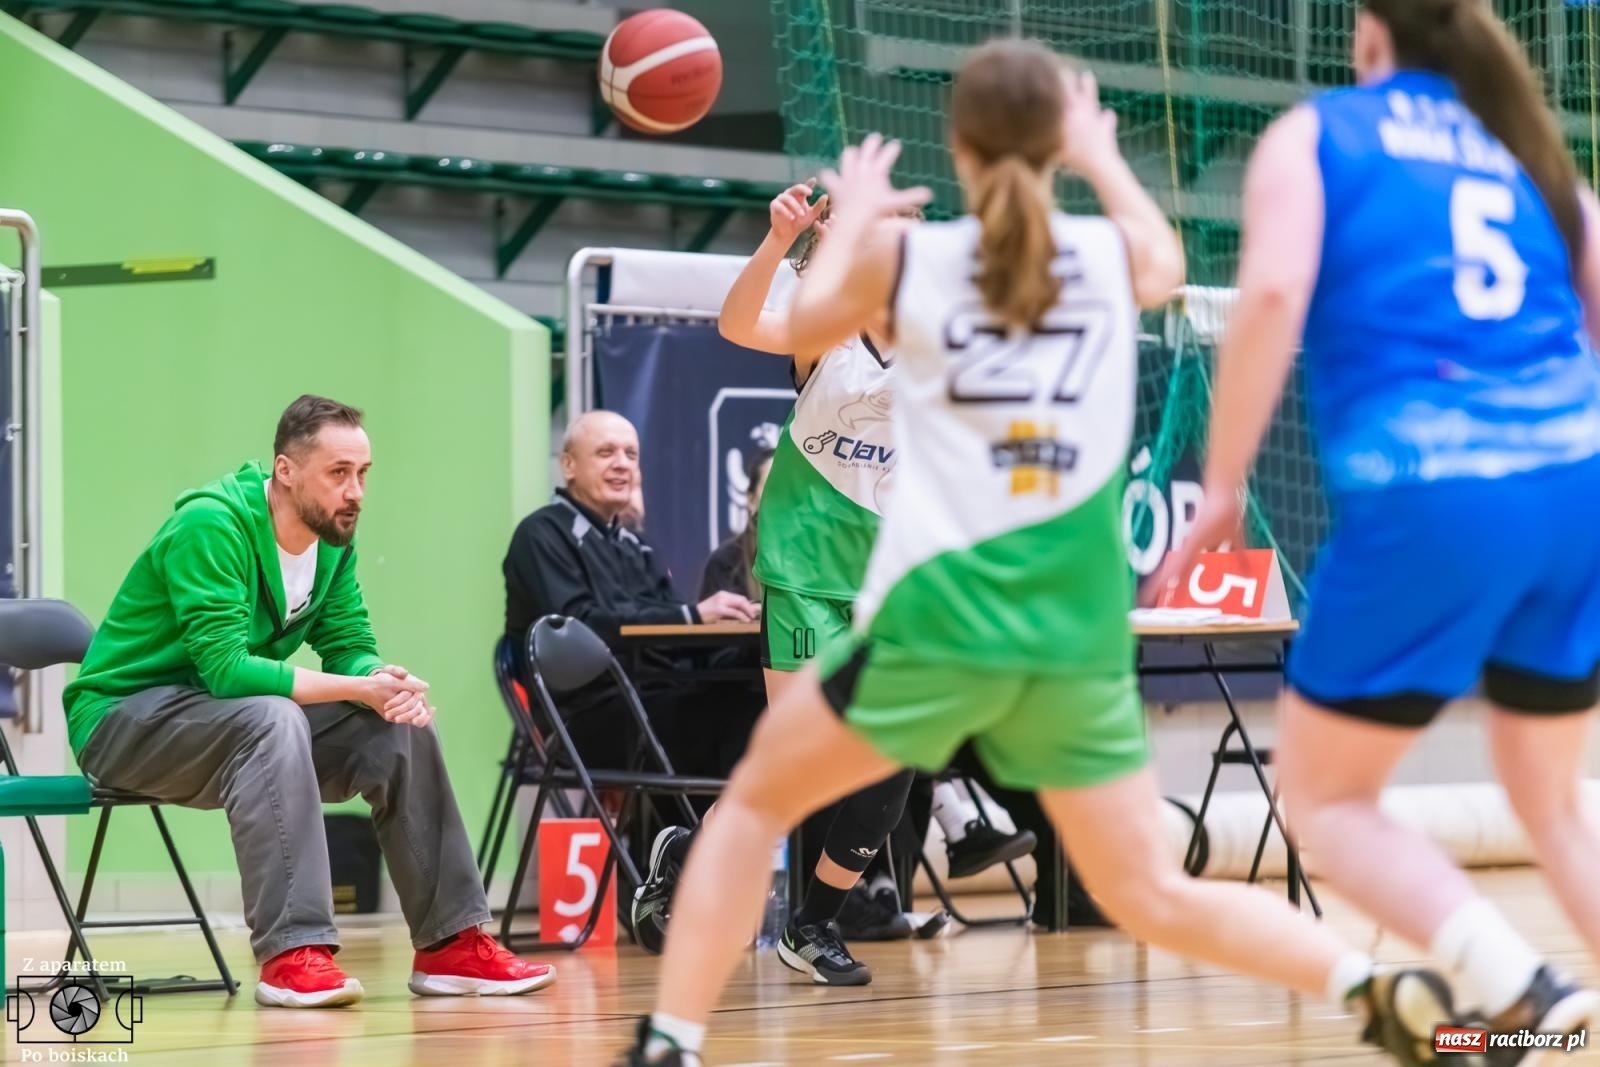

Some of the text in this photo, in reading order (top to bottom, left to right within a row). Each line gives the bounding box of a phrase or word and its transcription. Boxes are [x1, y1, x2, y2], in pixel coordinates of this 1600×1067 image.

[1449, 174, 1530, 321] 5
[944, 300, 1115, 404] 27
[833, 436, 896, 464] Clav
[1188, 563, 1258, 608] 5
[553, 832, 601, 917] 5
